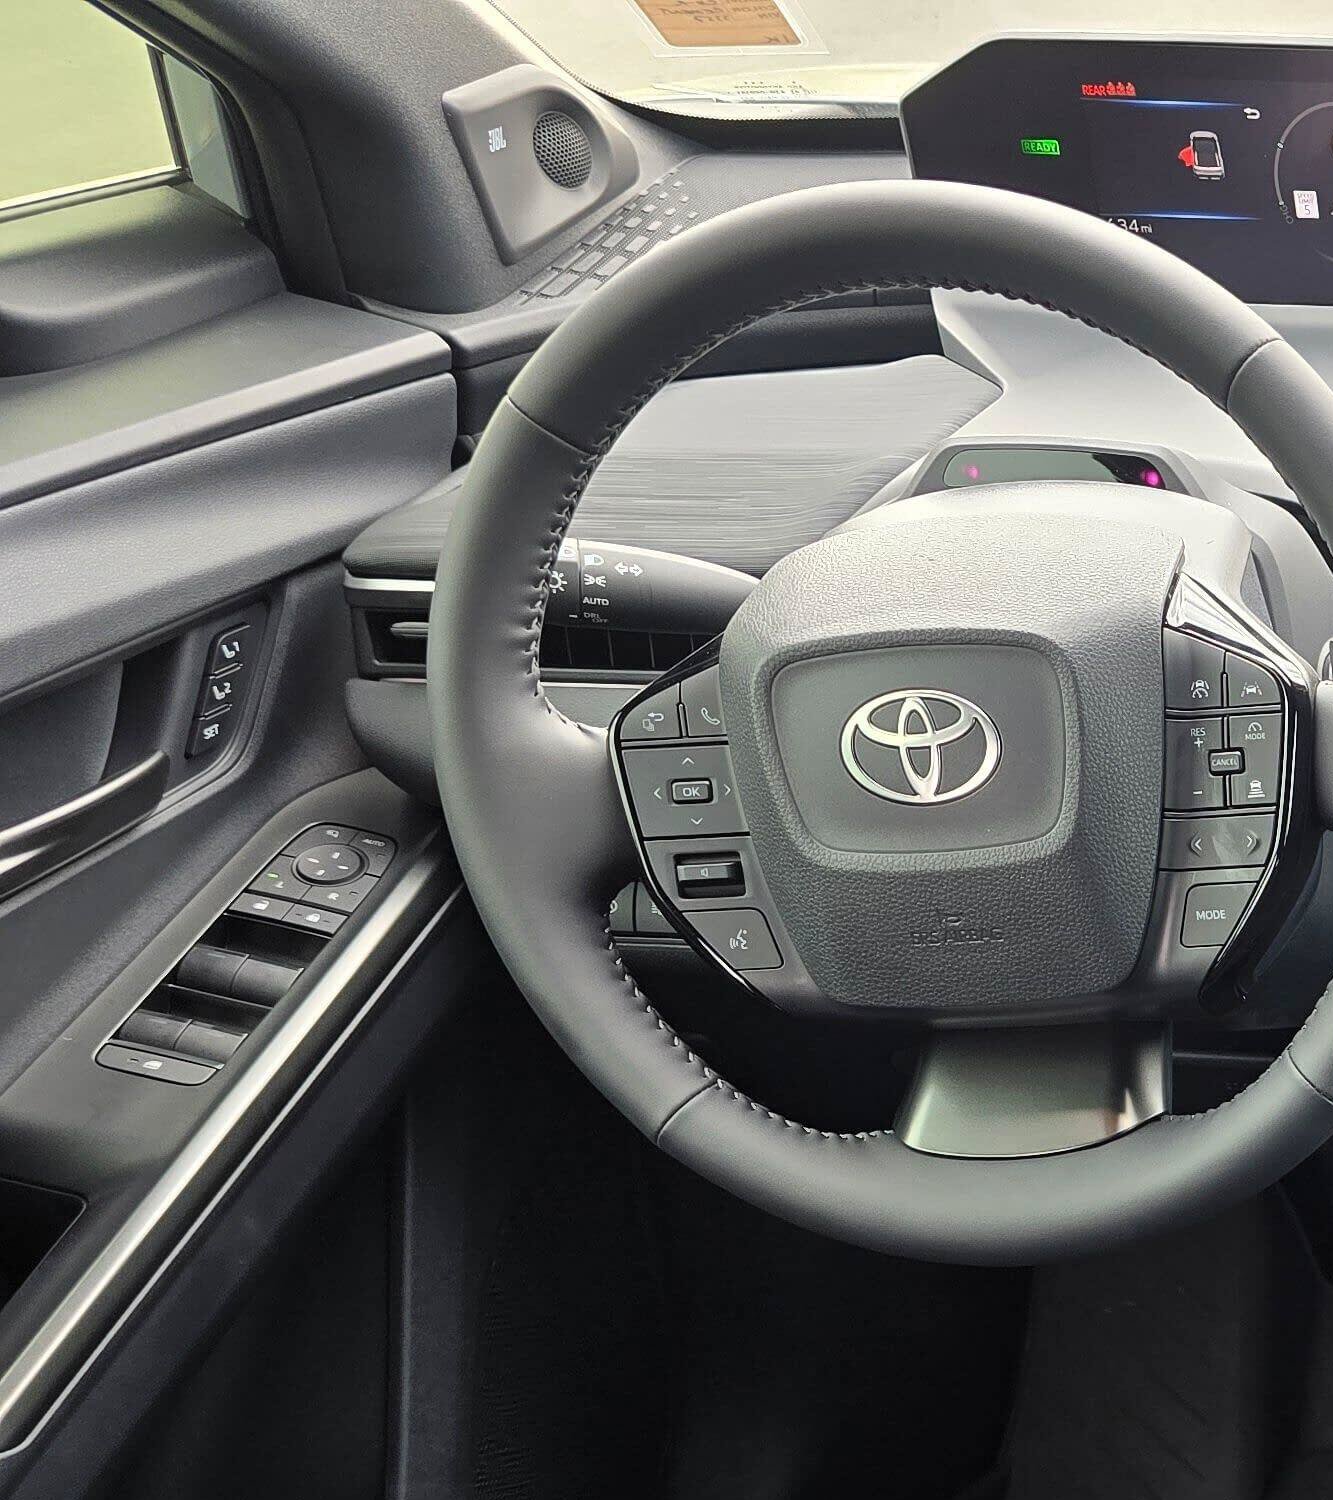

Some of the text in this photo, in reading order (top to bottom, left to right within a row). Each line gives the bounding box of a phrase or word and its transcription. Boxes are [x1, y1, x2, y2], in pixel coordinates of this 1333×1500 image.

[1081, 84, 1105, 96] REAR
[487, 126, 507, 152] JBL
[1023, 141, 1057, 153] READY
[1304, 204, 1311, 215] 5
[582, 596, 610, 606] AUTO
[203, 723, 220, 740] SET
[1190, 727, 1206, 737] RES
[1245, 732, 1266, 741] MODE
[1211, 757, 1238, 767] CANCEL
[682, 786, 701, 797] OK
[1195, 909, 1227, 921] MODE
